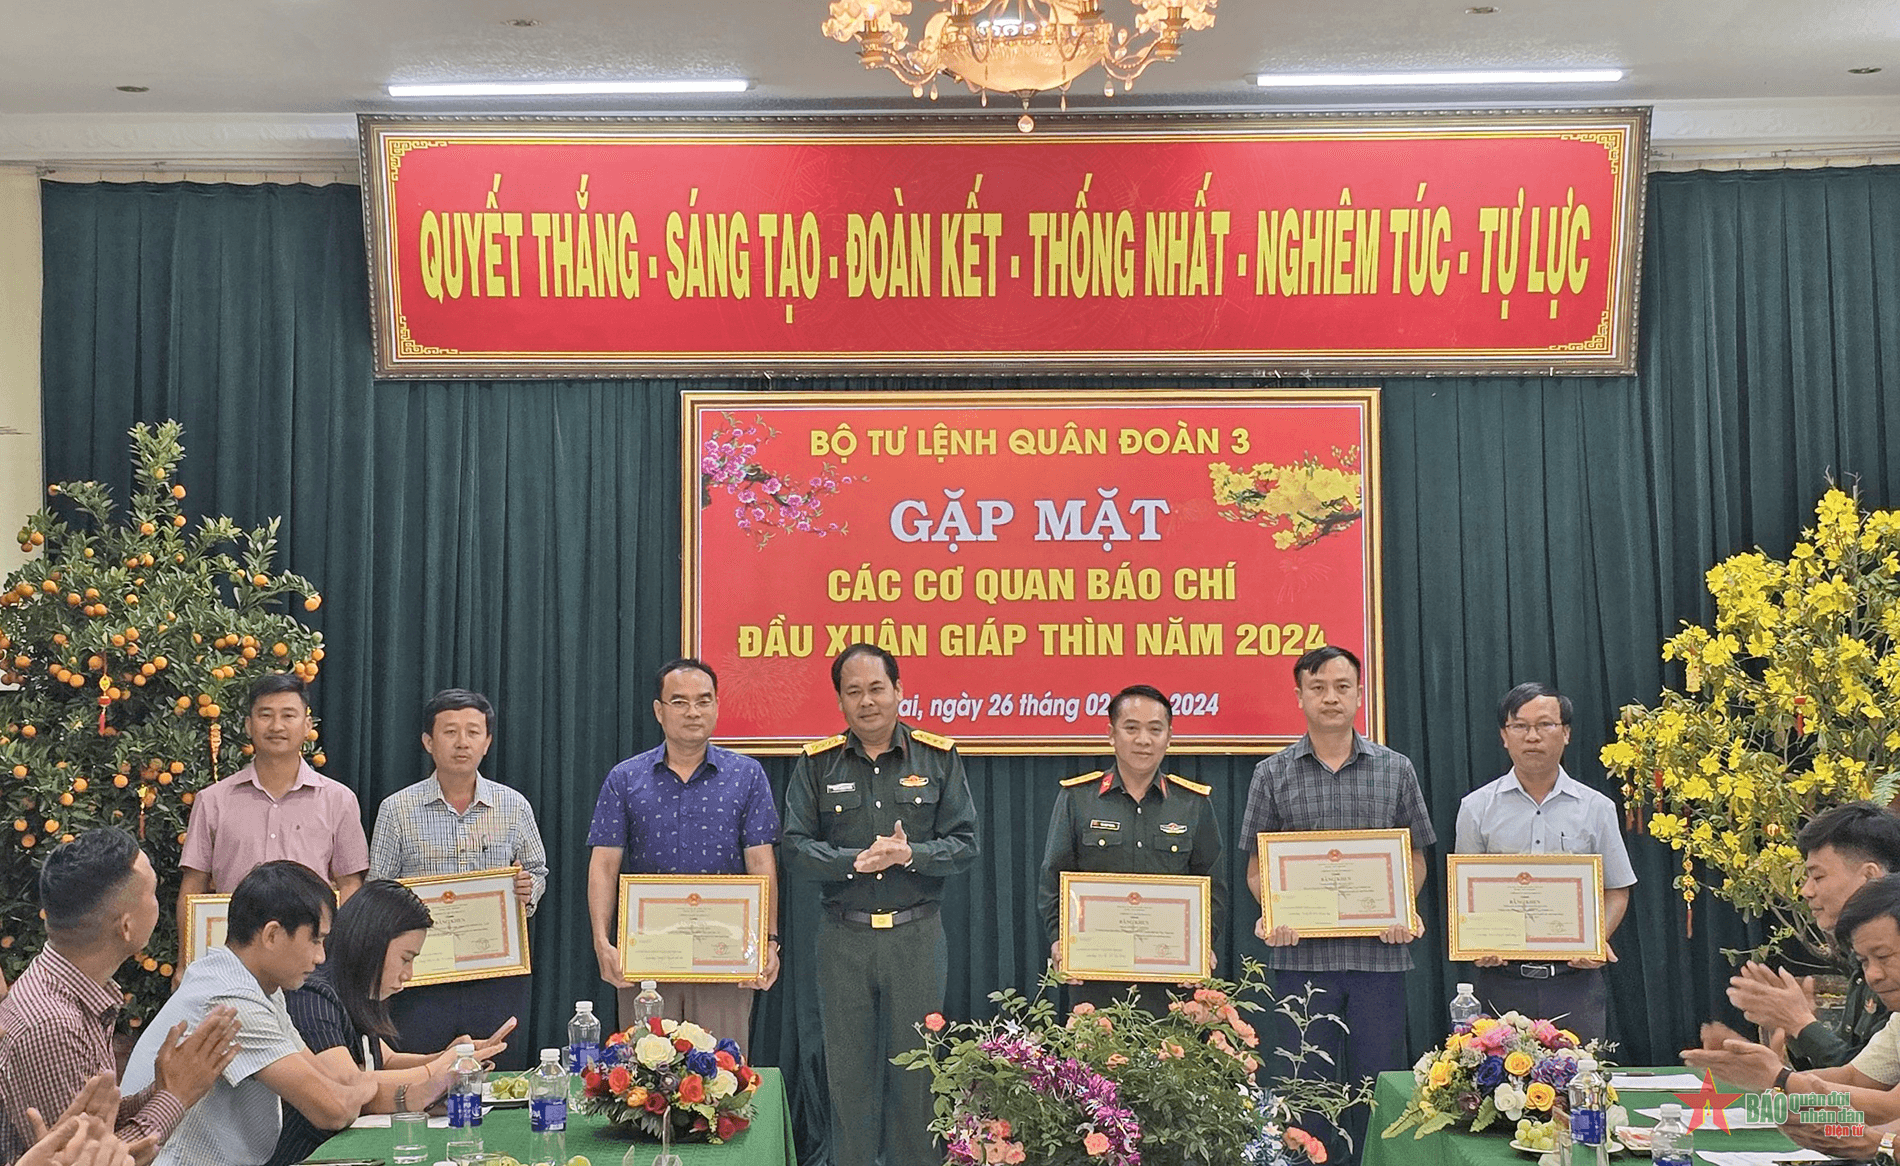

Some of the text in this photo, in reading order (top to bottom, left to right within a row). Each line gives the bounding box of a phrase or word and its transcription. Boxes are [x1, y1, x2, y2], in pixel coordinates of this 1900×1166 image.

[420, 173, 523, 304] QUYẾT
[531, 173, 640, 300] THẮNG
[666, 187, 751, 300] SÁNG
[759, 211, 821, 324] TẠO
[846, 187, 931, 300] ĐOÀN
[942, 173, 1003, 298] KẾT
[1029, 172, 1135, 299] THỐNG
[1144, 172, 1230, 298] NHẤT
[1255, 187, 1381, 297] NGHIÊM
[1390, 182, 1452, 296] TÚC
[1479, 187, 1526, 320] TỰ
[1527, 186, 1591, 320] LỰC
[810, 421, 1251, 464] BỘ TƯ LỆNH QUÂN ĐOÀN 3
[889, 487, 1171, 553] GẶP MẶT
[827, 560, 1236, 605] CÁC CƠ QUAN BÁO CHÍ
[738, 614, 1328, 658] ĐẦU XUÂN GIÁP THÌN NĂM 2024
[897, 691, 1219, 723] ai, ngày 26 tháng 02 2024
